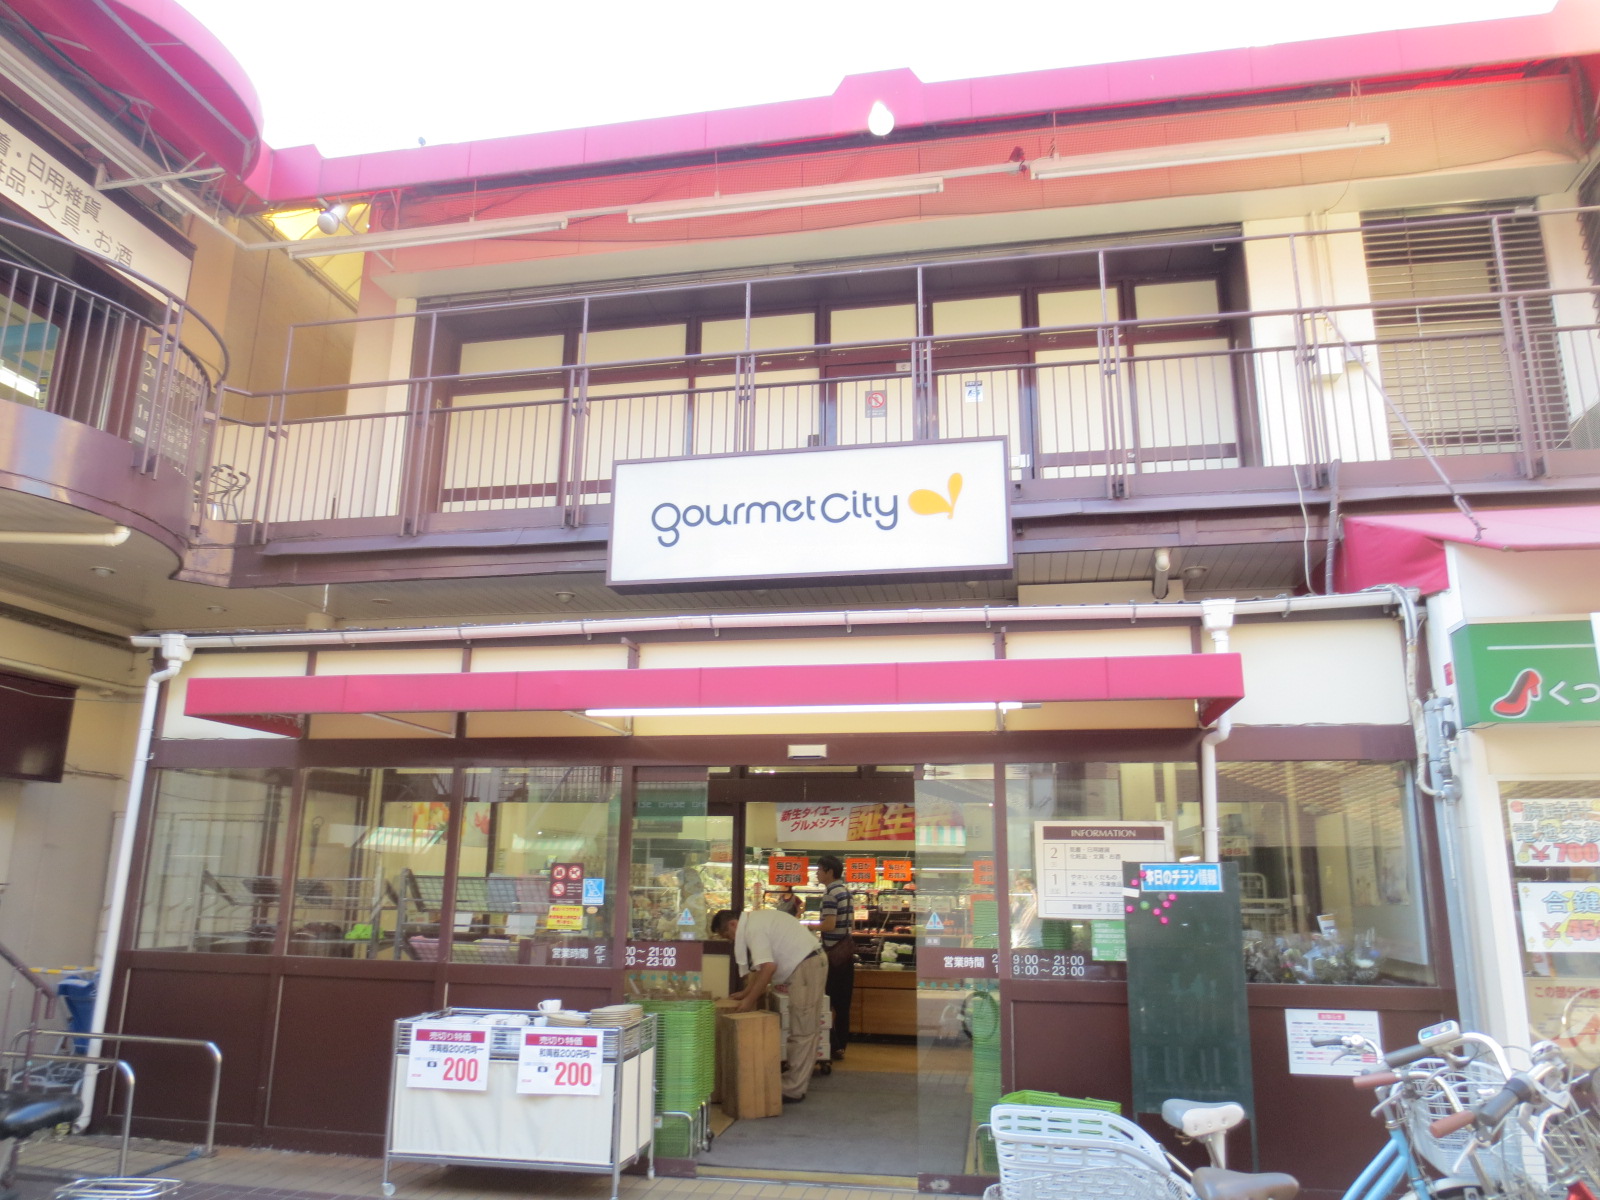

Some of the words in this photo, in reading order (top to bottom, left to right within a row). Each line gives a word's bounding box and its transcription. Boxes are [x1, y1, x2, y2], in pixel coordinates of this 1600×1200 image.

[789, 816, 849, 833] グルメシティ
[1070, 829, 1137, 838] INFORMATION
[1050, 847, 1058, 859] 2
[1052, 873, 1058, 885] 1
[1145, 868, 1218, 886] 本日のチラシ情報
[1541, 890, 1600, 914] 合鍵
[1539, 919, 1600, 941] ¥45
[551, 947, 589, 959] 営業時間
[593, 945, 607, 955] 2F
[596, 955, 606, 964] 1F
[943, 955, 985, 969] 営業時間
[429, 1031, 472, 1042] 売切り特価
[538, 1036, 584, 1046] 売切り特価
[443, 1056, 479, 1083] 200
[554, 1061, 592, 1087] 200
